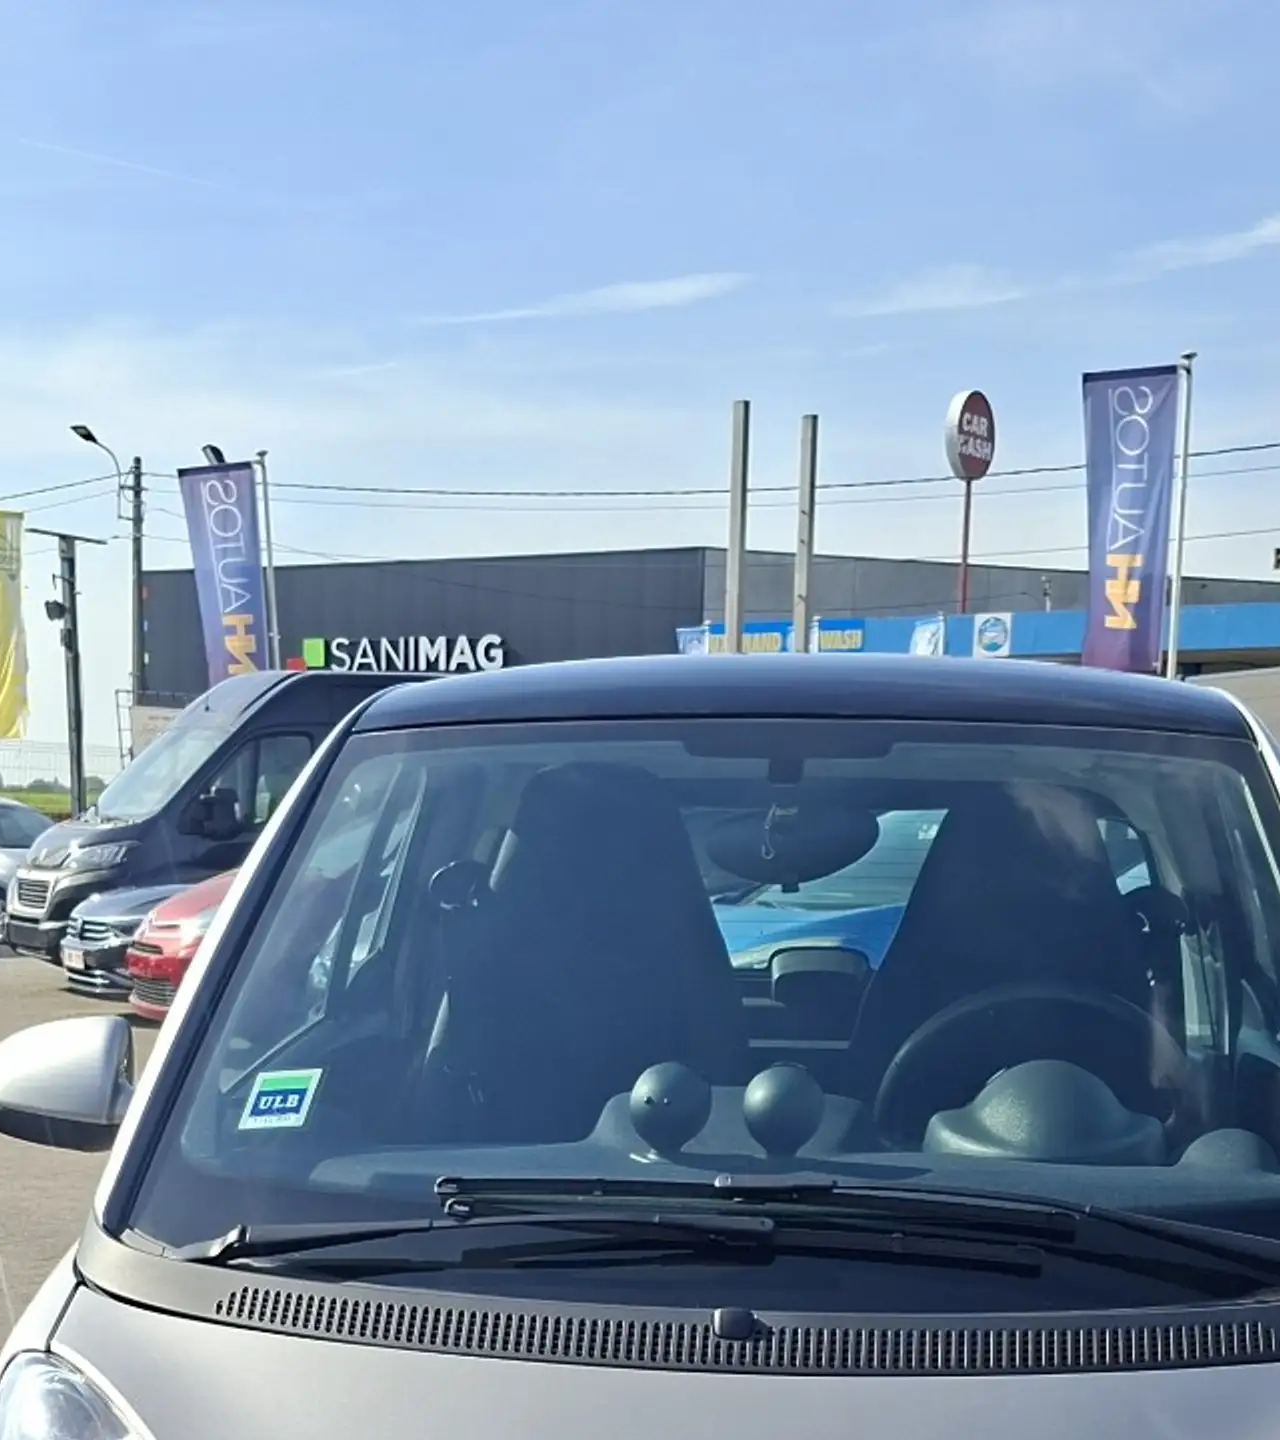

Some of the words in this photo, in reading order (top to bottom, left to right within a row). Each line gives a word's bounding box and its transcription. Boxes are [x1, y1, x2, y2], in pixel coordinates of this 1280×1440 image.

[961, 411, 988, 438] CAR
[330, 633, 504, 672] SANIMAG
[257, 1093, 301, 1110] ULB
